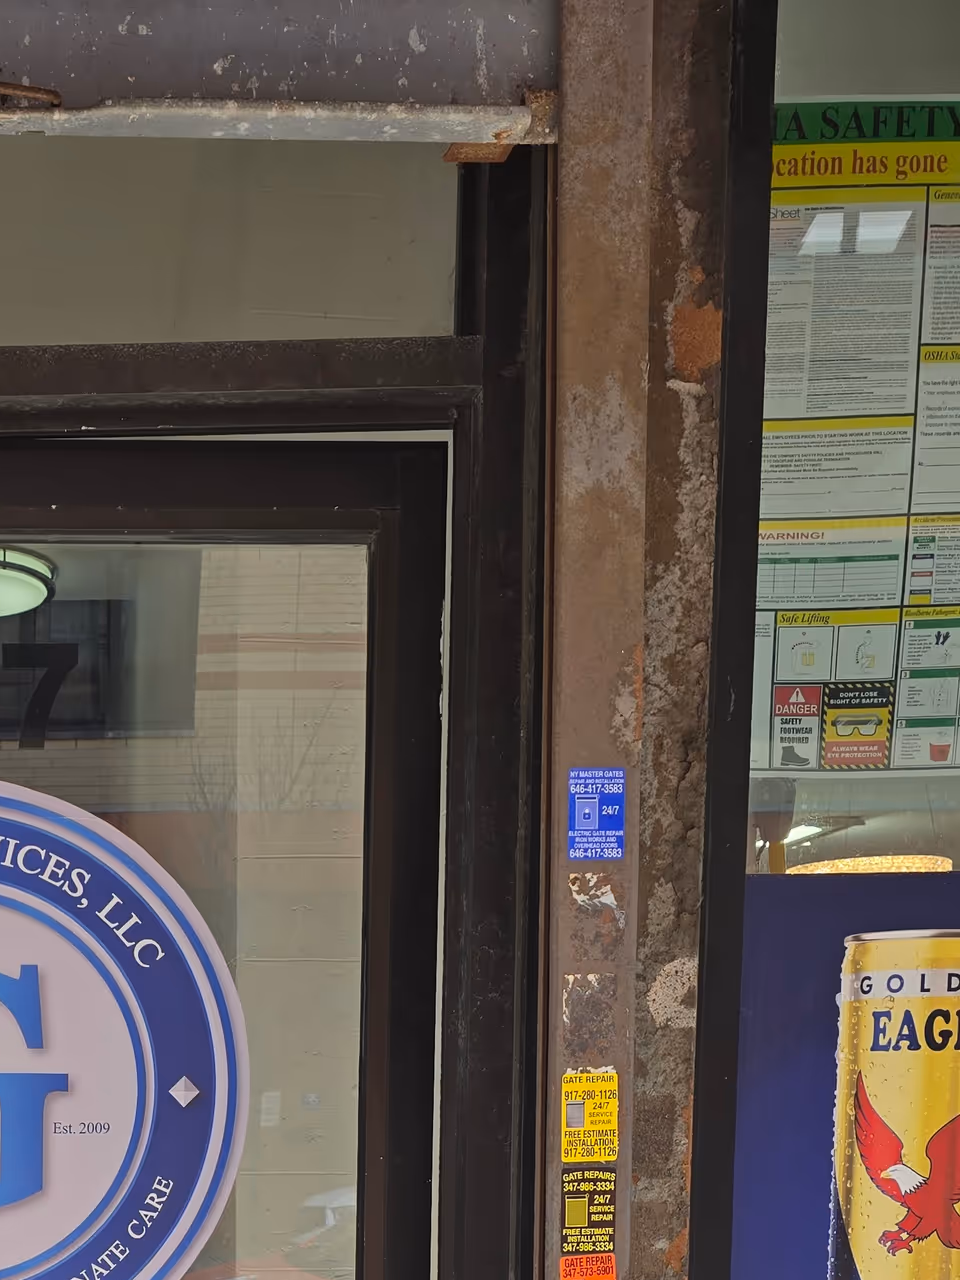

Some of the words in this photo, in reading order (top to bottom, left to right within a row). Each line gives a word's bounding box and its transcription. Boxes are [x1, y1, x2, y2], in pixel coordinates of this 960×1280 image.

[772, 151, 843, 176] cation
[851, 149, 888, 175] has
[896, 154, 947, 180] gone
[770, 208, 800, 219] Sheet
[925, 351, 948, 360] OSHA
[758, 532, 824, 540] WARNING!
[780, 614, 798, 625] Safe
[801, 613, 830, 624] Lifting
[776, 705, 817, 714] DANGER
[571, 784, 623, 793] 646-417-3583
[602, 806, 619, 814] 24/7
[570, 849, 621, 857] 646-417-3583
[96, 893, 164, 968] LLC
[565, 1090, 617, 1100] 917-280-1126
[53, 1122, 76, 1134] Est.
[79, 1122, 110, 1135] 2009
[584, 1129, 616, 1138] ESTIMATE
[567, 1138, 614, 1147] INSTALLATION
[564, 1147, 616, 1158] 917-280-1126
[563, 1172, 582, 1181] GATE
[584, 1171, 615, 1180] REPAIRS
[563, 1182, 614, 1191] 347-986-3334
[594, 1195, 610, 1203] 24/7
[127, 1175, 174, 1239] CARE
[563, 1242, 613, 1251] 347-986-3334
[565, 1258, 583, 1268] GATE
[586, 1255, 612, 1266] REPAIR
[563, 1266, 613, 1278] 347-573-5901
